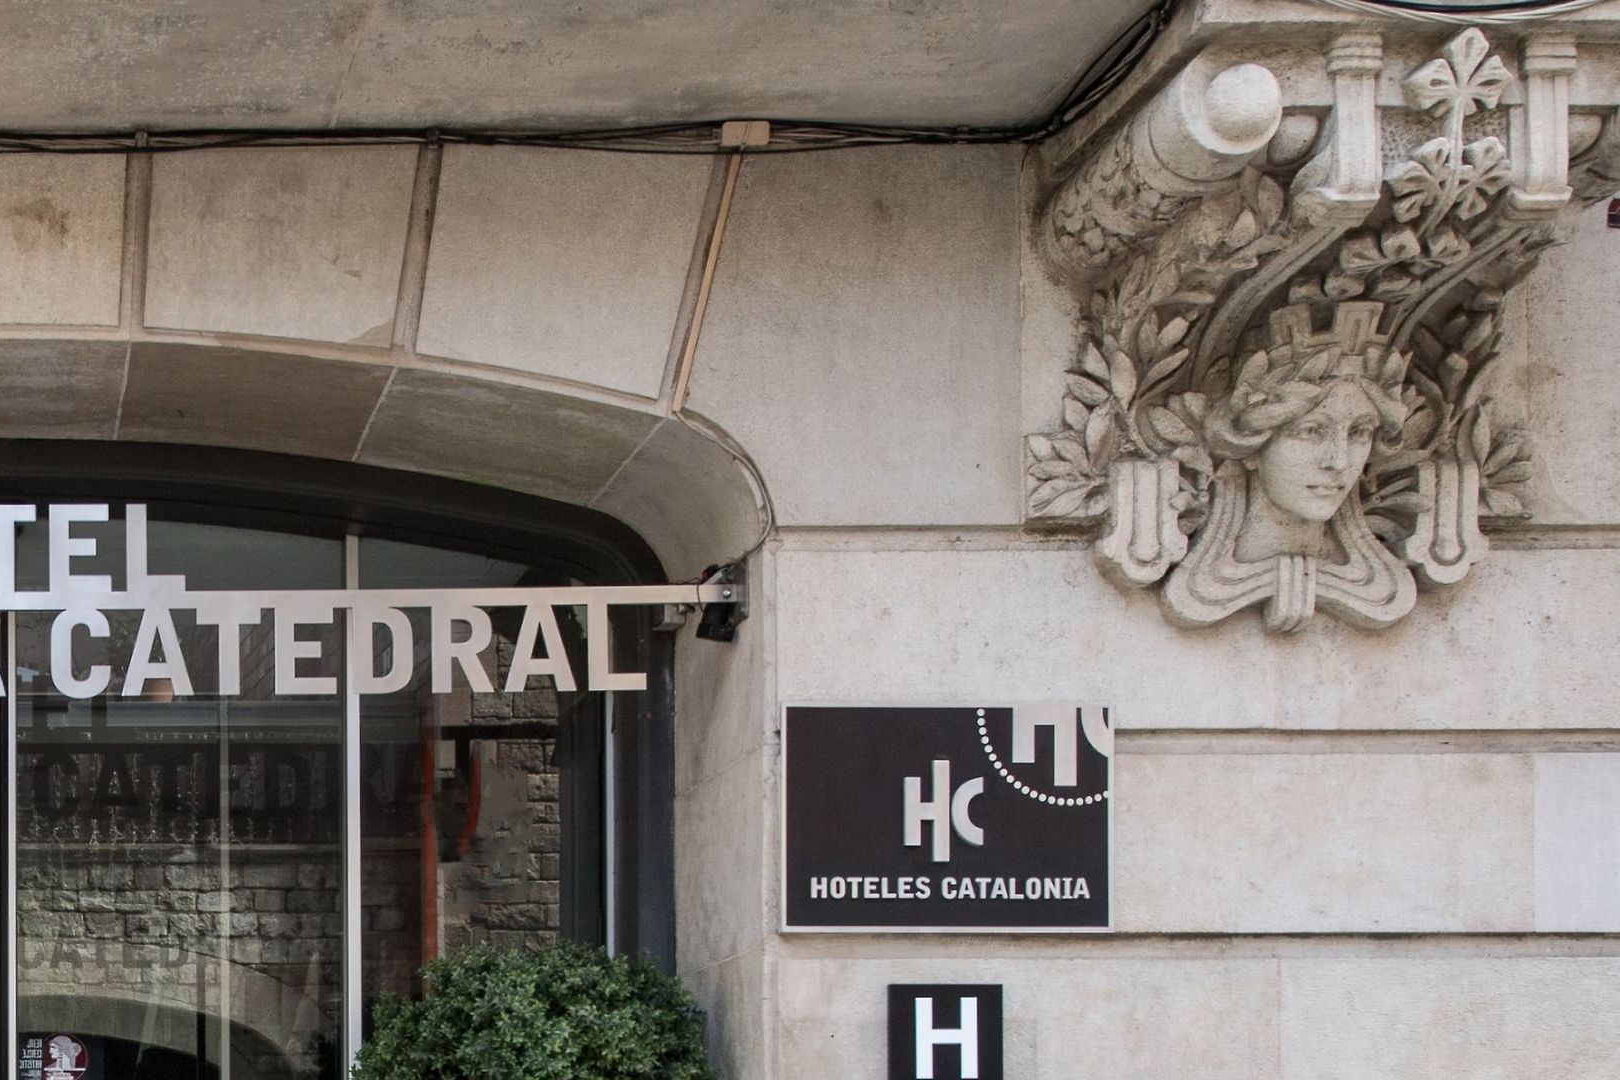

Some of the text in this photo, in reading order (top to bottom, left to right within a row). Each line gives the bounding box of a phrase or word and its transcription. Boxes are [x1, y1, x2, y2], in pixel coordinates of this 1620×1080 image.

[49, 600, 648, 699] CATEDRAL
[903, 759, 985, 863] HC
[810, 876, 1091, 900] HOTELES CATALONIA
[914, 996, 979, 1080] H
